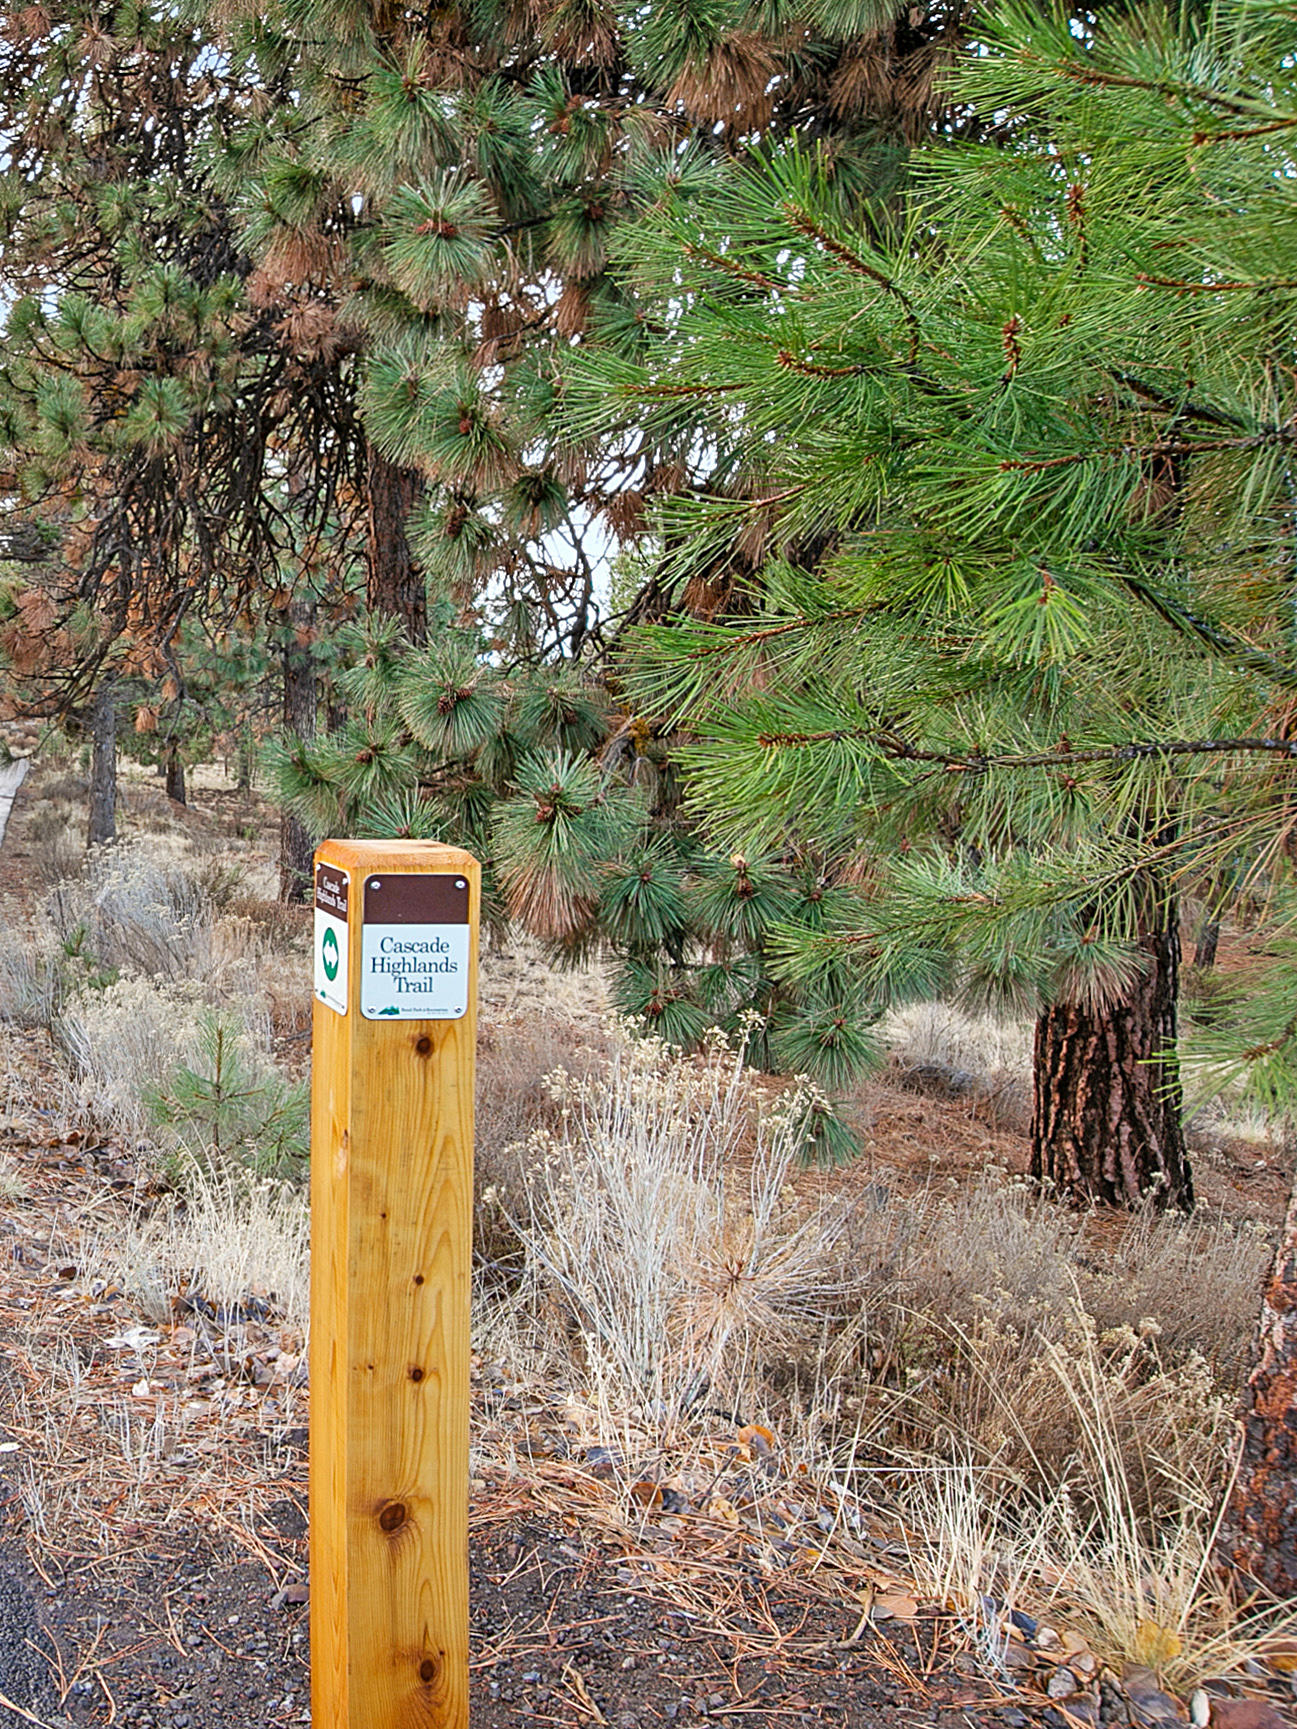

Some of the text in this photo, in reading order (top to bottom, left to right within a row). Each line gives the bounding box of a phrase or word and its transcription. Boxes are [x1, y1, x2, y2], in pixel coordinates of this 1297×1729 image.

[380, 936, 450, 954] Cascade
[370, 956, 458, 977] Highlands
[393, 976, 433, 993] Trail
